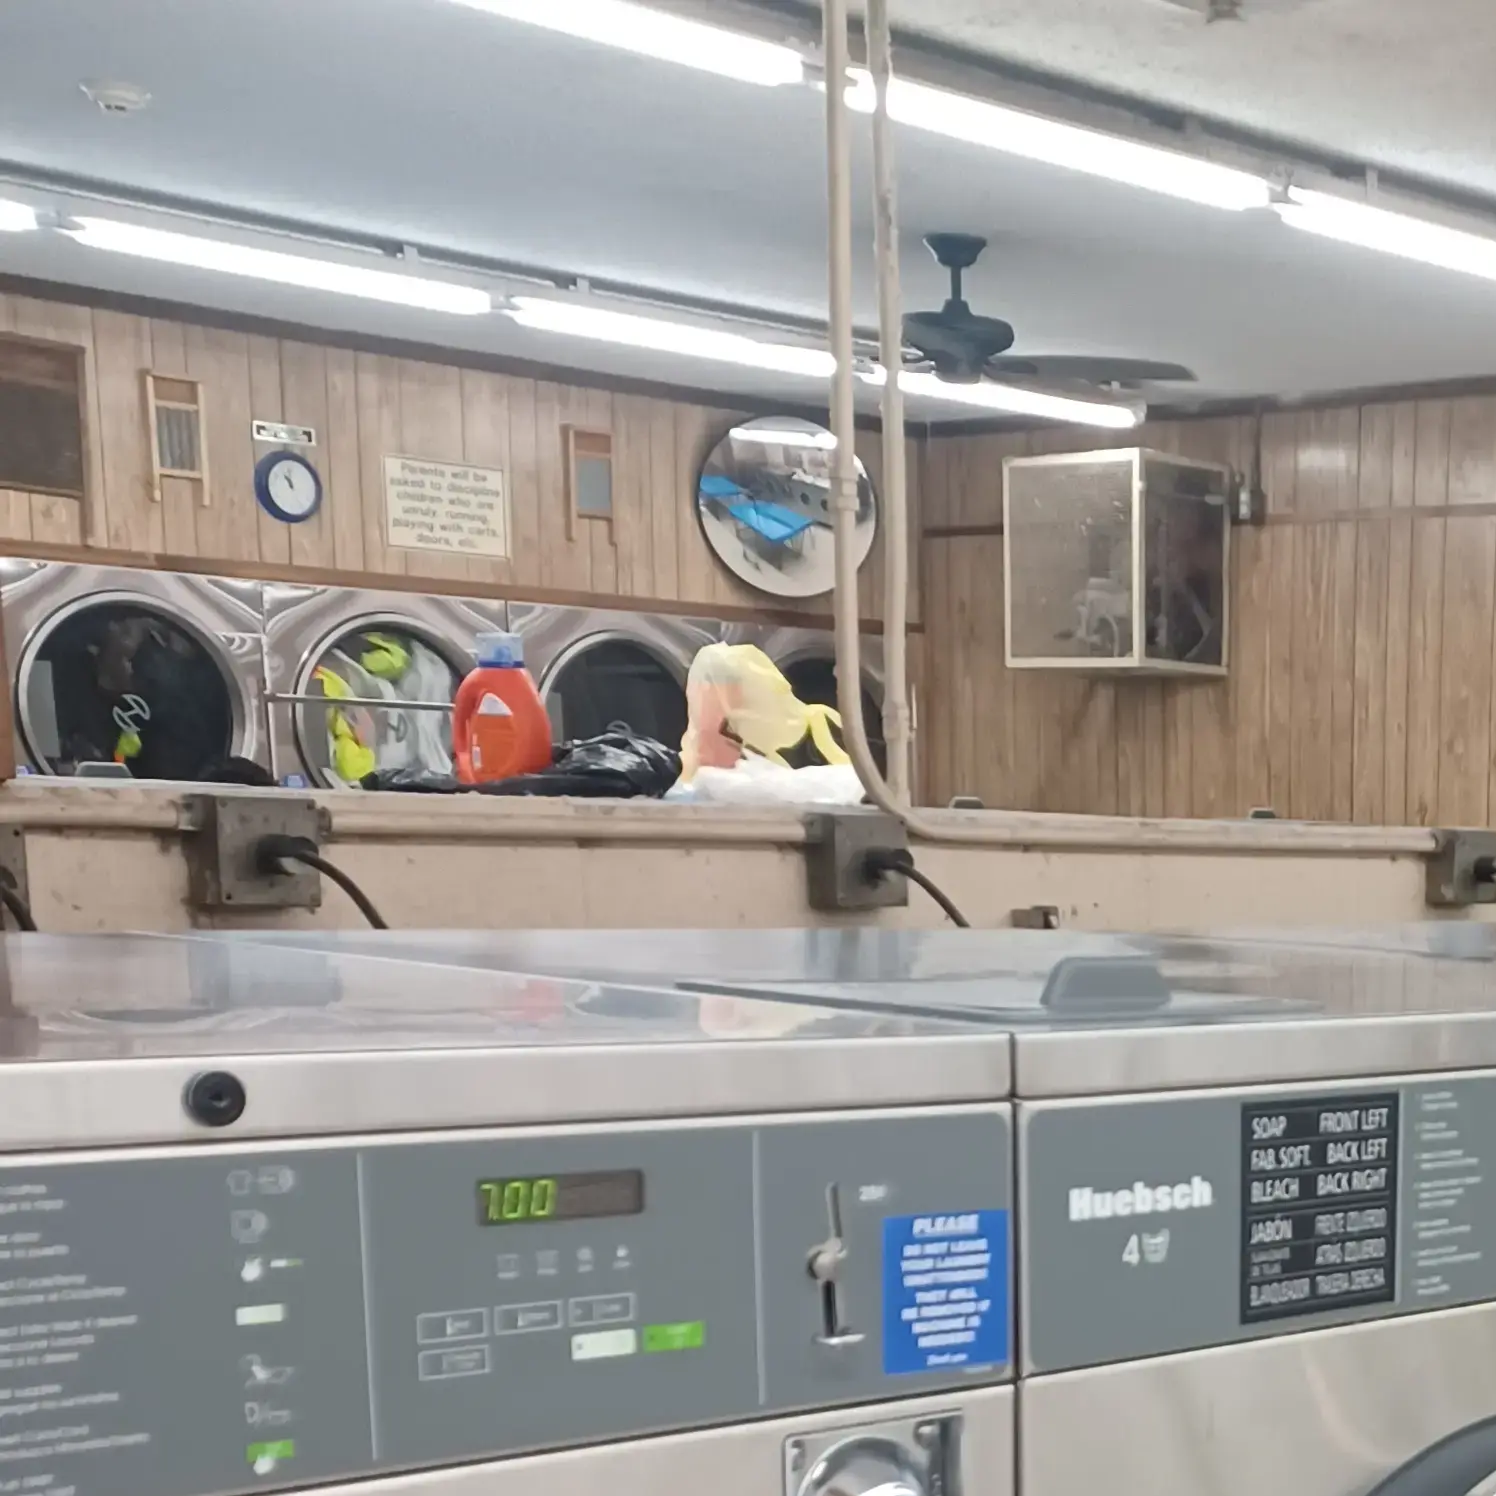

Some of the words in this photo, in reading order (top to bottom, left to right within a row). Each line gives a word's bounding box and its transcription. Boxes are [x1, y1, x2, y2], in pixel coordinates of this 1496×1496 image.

[401, 462, 445, 478] Parents
[451, 470, 469, 481] will
[473, 472, 487, 482] be
[430, 480, 441, 491] to
[449, 495, 471, 508] who
[440, 523, 463, 534] with
[1252, 1116, 1287, 1139] SOAP
[1319, 1110, 1359, 1133] FRONT
[1361, 1108, 1388, 1130] LEFT
[1327, 1141, 1359, 1164] BACK
[1361, 1138, 1387, 1160] LEFT
[1251, 1178, 1299, 1203] BLEACH
[1317, 1172, 1350, 1196] BACK
[1351, 1168, 1387, 1191] RIGHT
[1069, 1175, 1212, 1221] Huebsch
